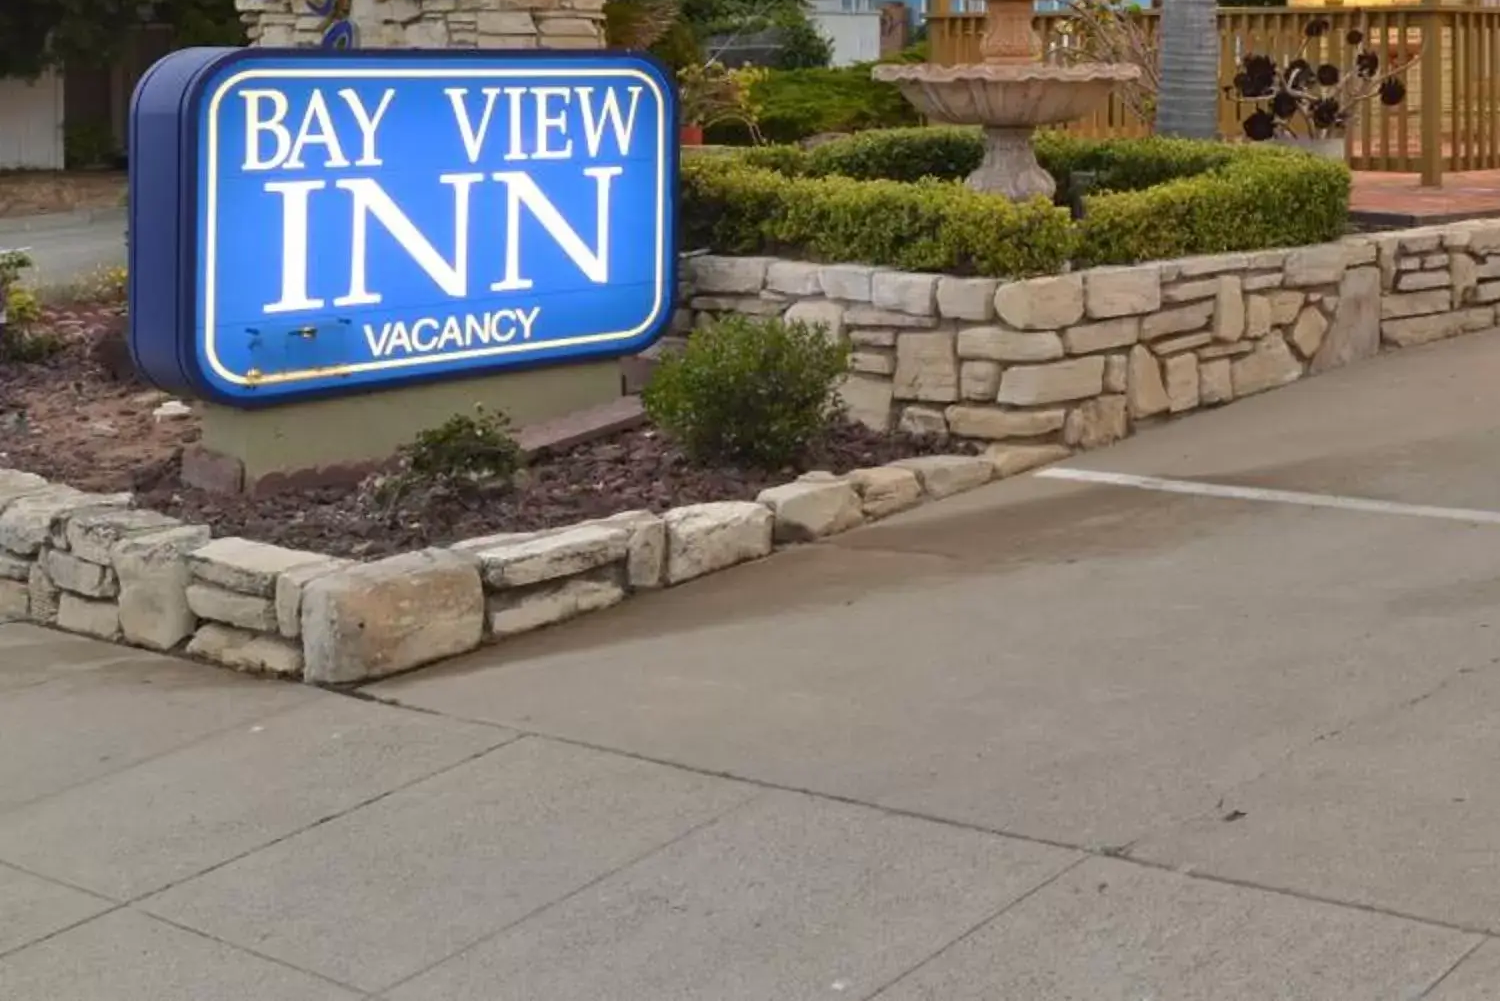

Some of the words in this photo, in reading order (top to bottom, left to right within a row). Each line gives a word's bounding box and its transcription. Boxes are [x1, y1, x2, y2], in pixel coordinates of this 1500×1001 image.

[238, 87, 396, 172] BAY
[444, 85, 643, 164] VIEW
[262, 166, 623, 314] INN
[363, 306, 541, 358] VACANCY
